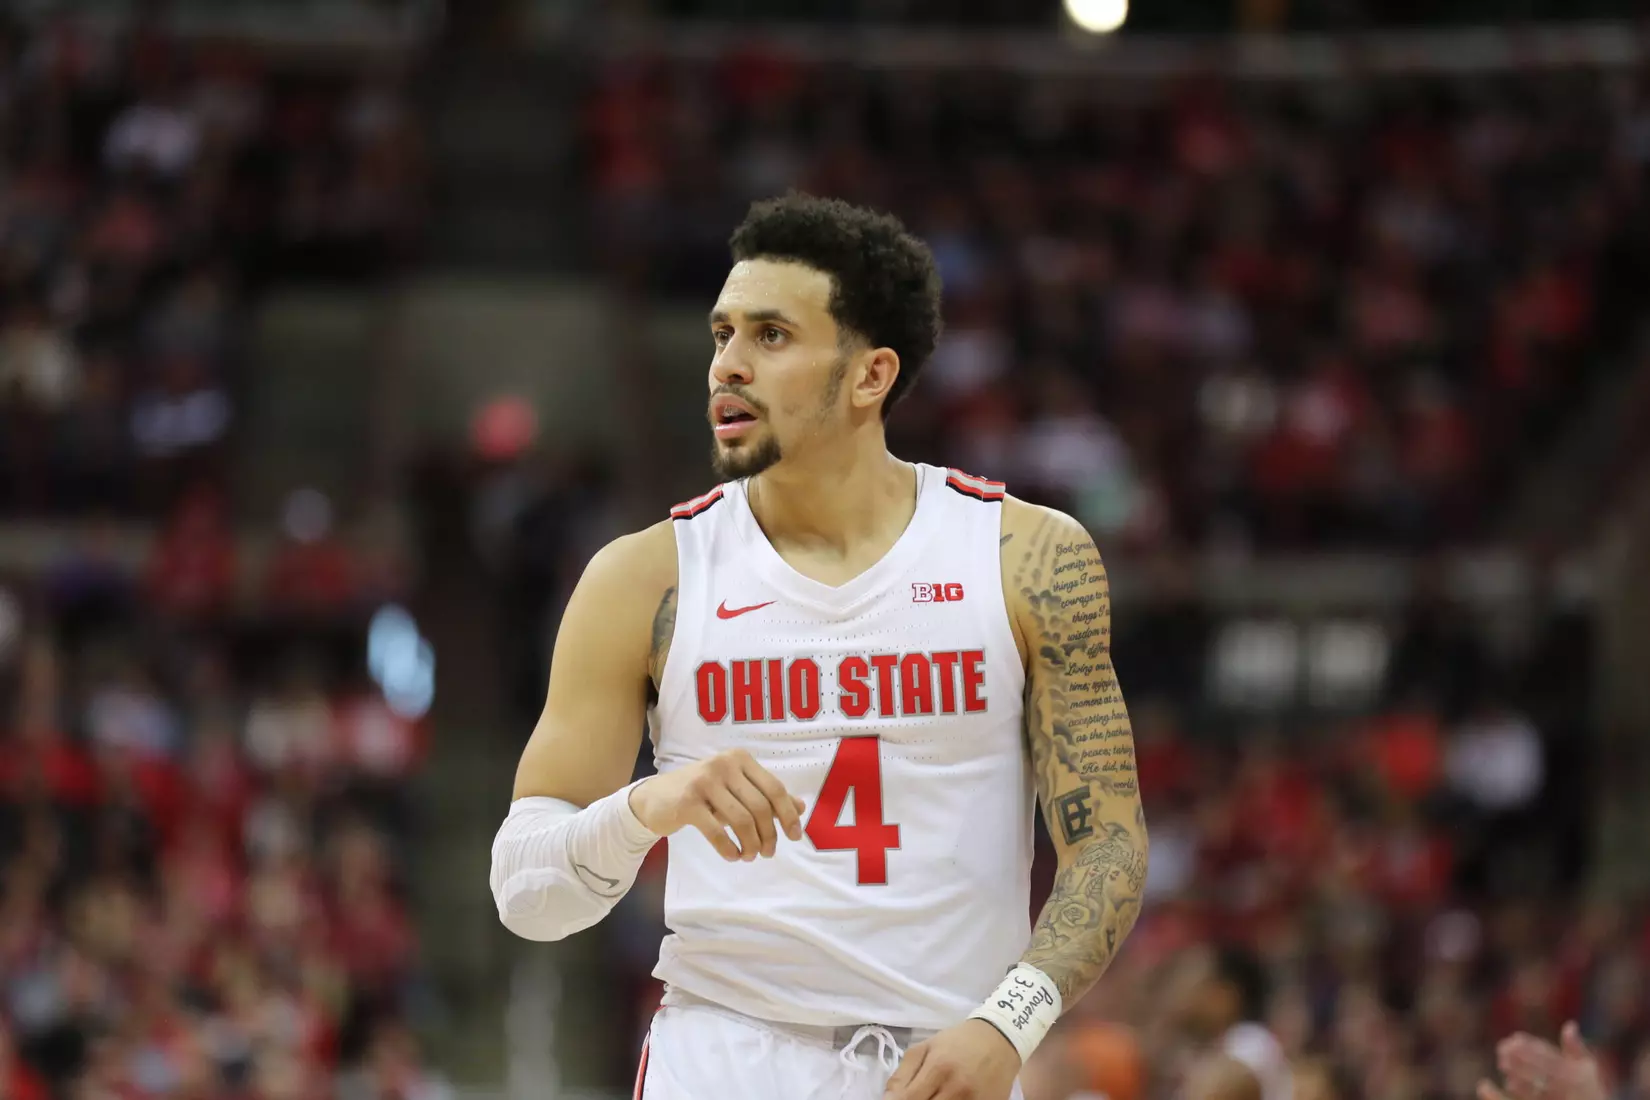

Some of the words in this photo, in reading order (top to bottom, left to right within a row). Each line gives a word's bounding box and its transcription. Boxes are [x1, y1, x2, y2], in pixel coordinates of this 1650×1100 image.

[1053, 559, 1086, 576] serenity
[1053, 580, 1079, 593] things
[1061, 593, 1095, 608] courage
[1072, 611, 1097, 625] things
[1067, 627, 1100, 642] wisdom
[1064, 662, 1093, 676] Living
[694, 657, 823, 725] OHIO
[837, 649, 988, 719] STATE
[1070, 697, 1103, 709] moment
[1068, 713, 1110, 728] accepting
[1076, 734, 1088, 743] as
[1089, 729, 1104, 740] the
[1081, 762, 1099, 775] He
[803, 734, 901, 886] 4
[1012, 985, 1054, 1030] Proverbs
